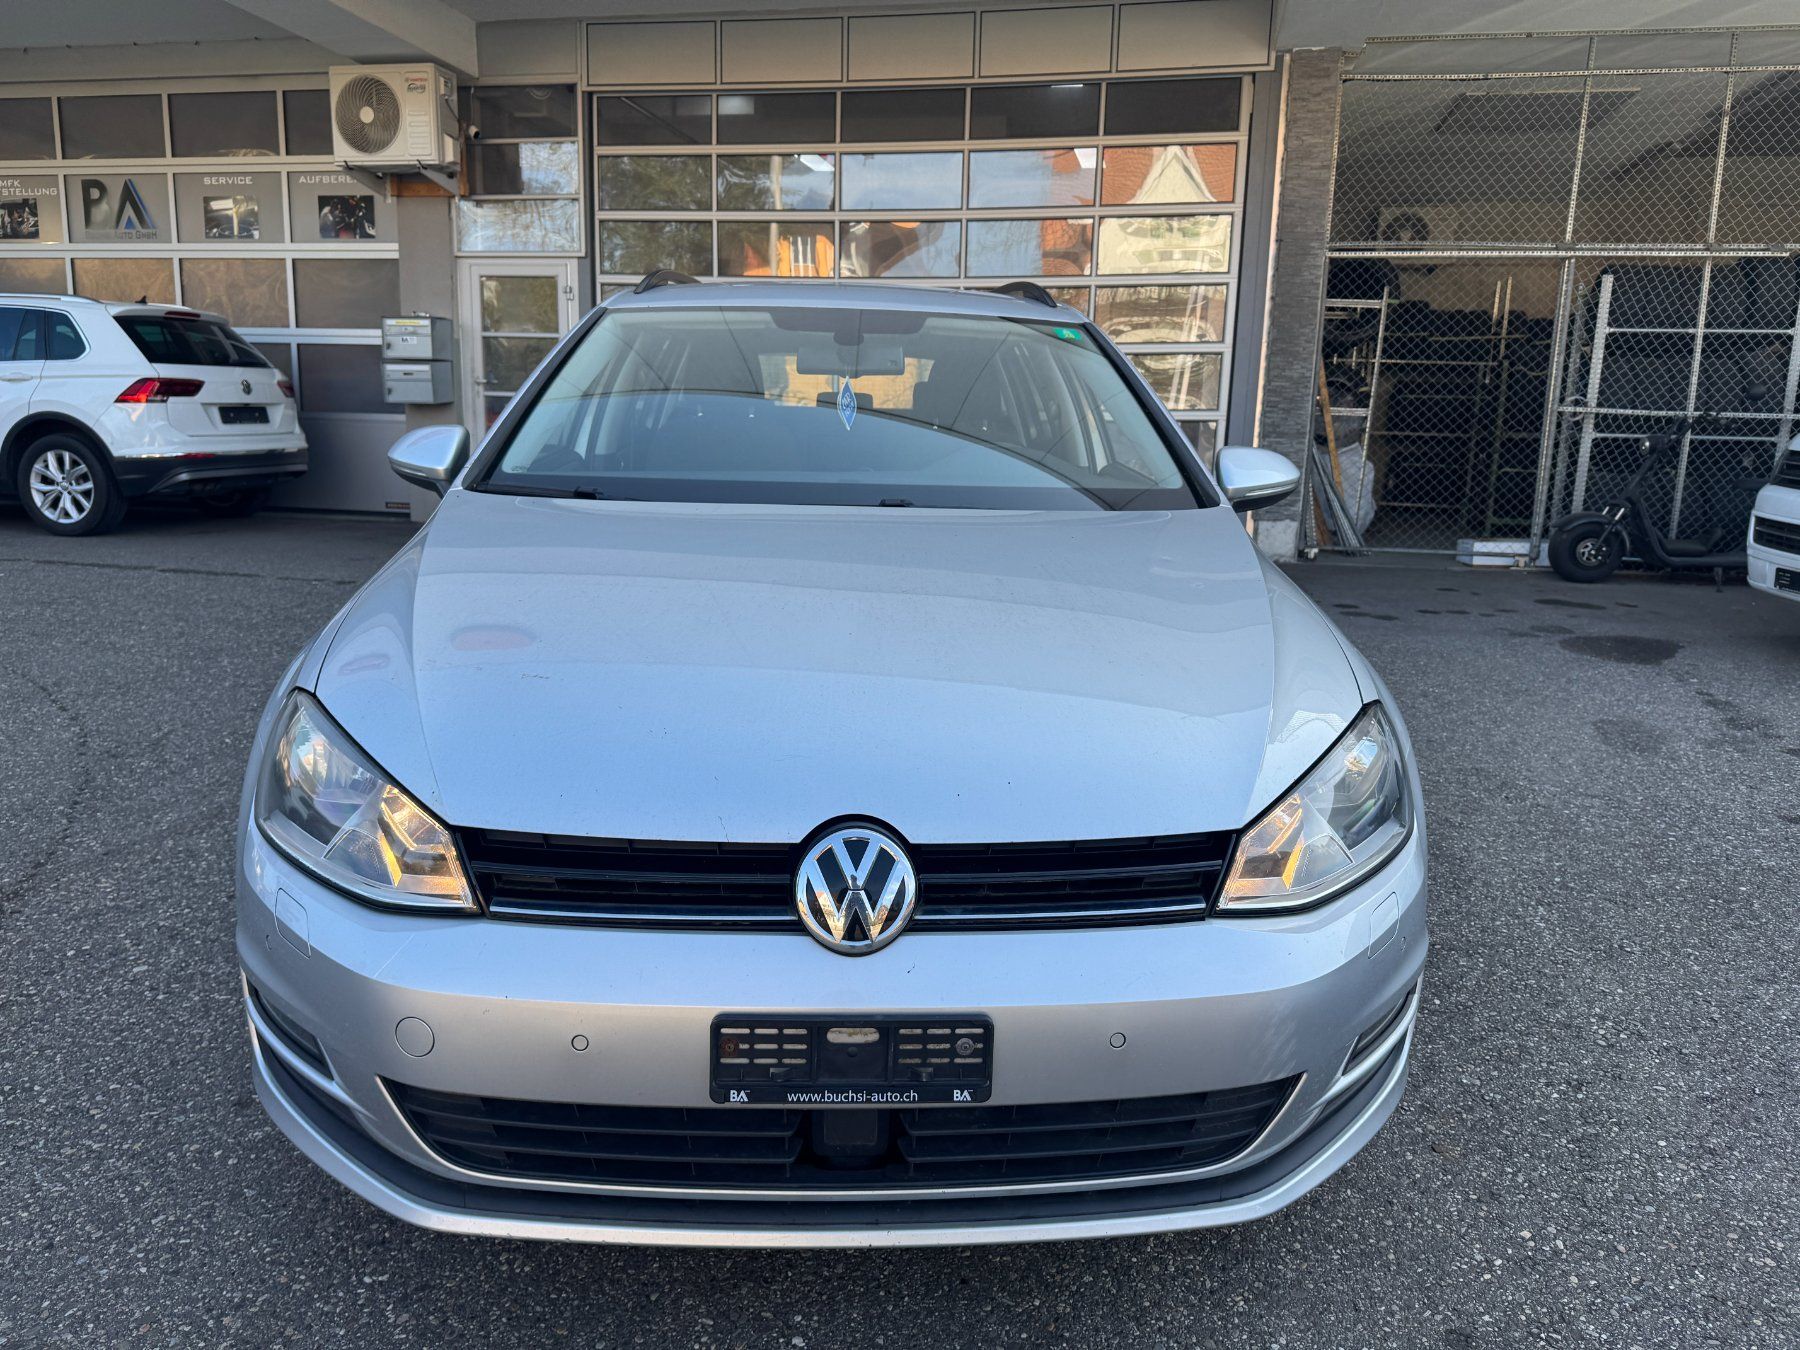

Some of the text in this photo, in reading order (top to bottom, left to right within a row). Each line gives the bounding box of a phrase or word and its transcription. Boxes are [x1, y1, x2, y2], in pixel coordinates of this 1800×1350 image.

[203, 176, 253, 185] SERVICE
[298, 175, 357, 184] AUFBERE
[0, 187, 58, 196] STELLUNG
[800, 832, 912, 948] VW
[729, 1089, 750, 1102] BA
[787, 1089, 918, 1102] www.buchsi-auto.ch
[953, 1088, 973, 1101] BA
